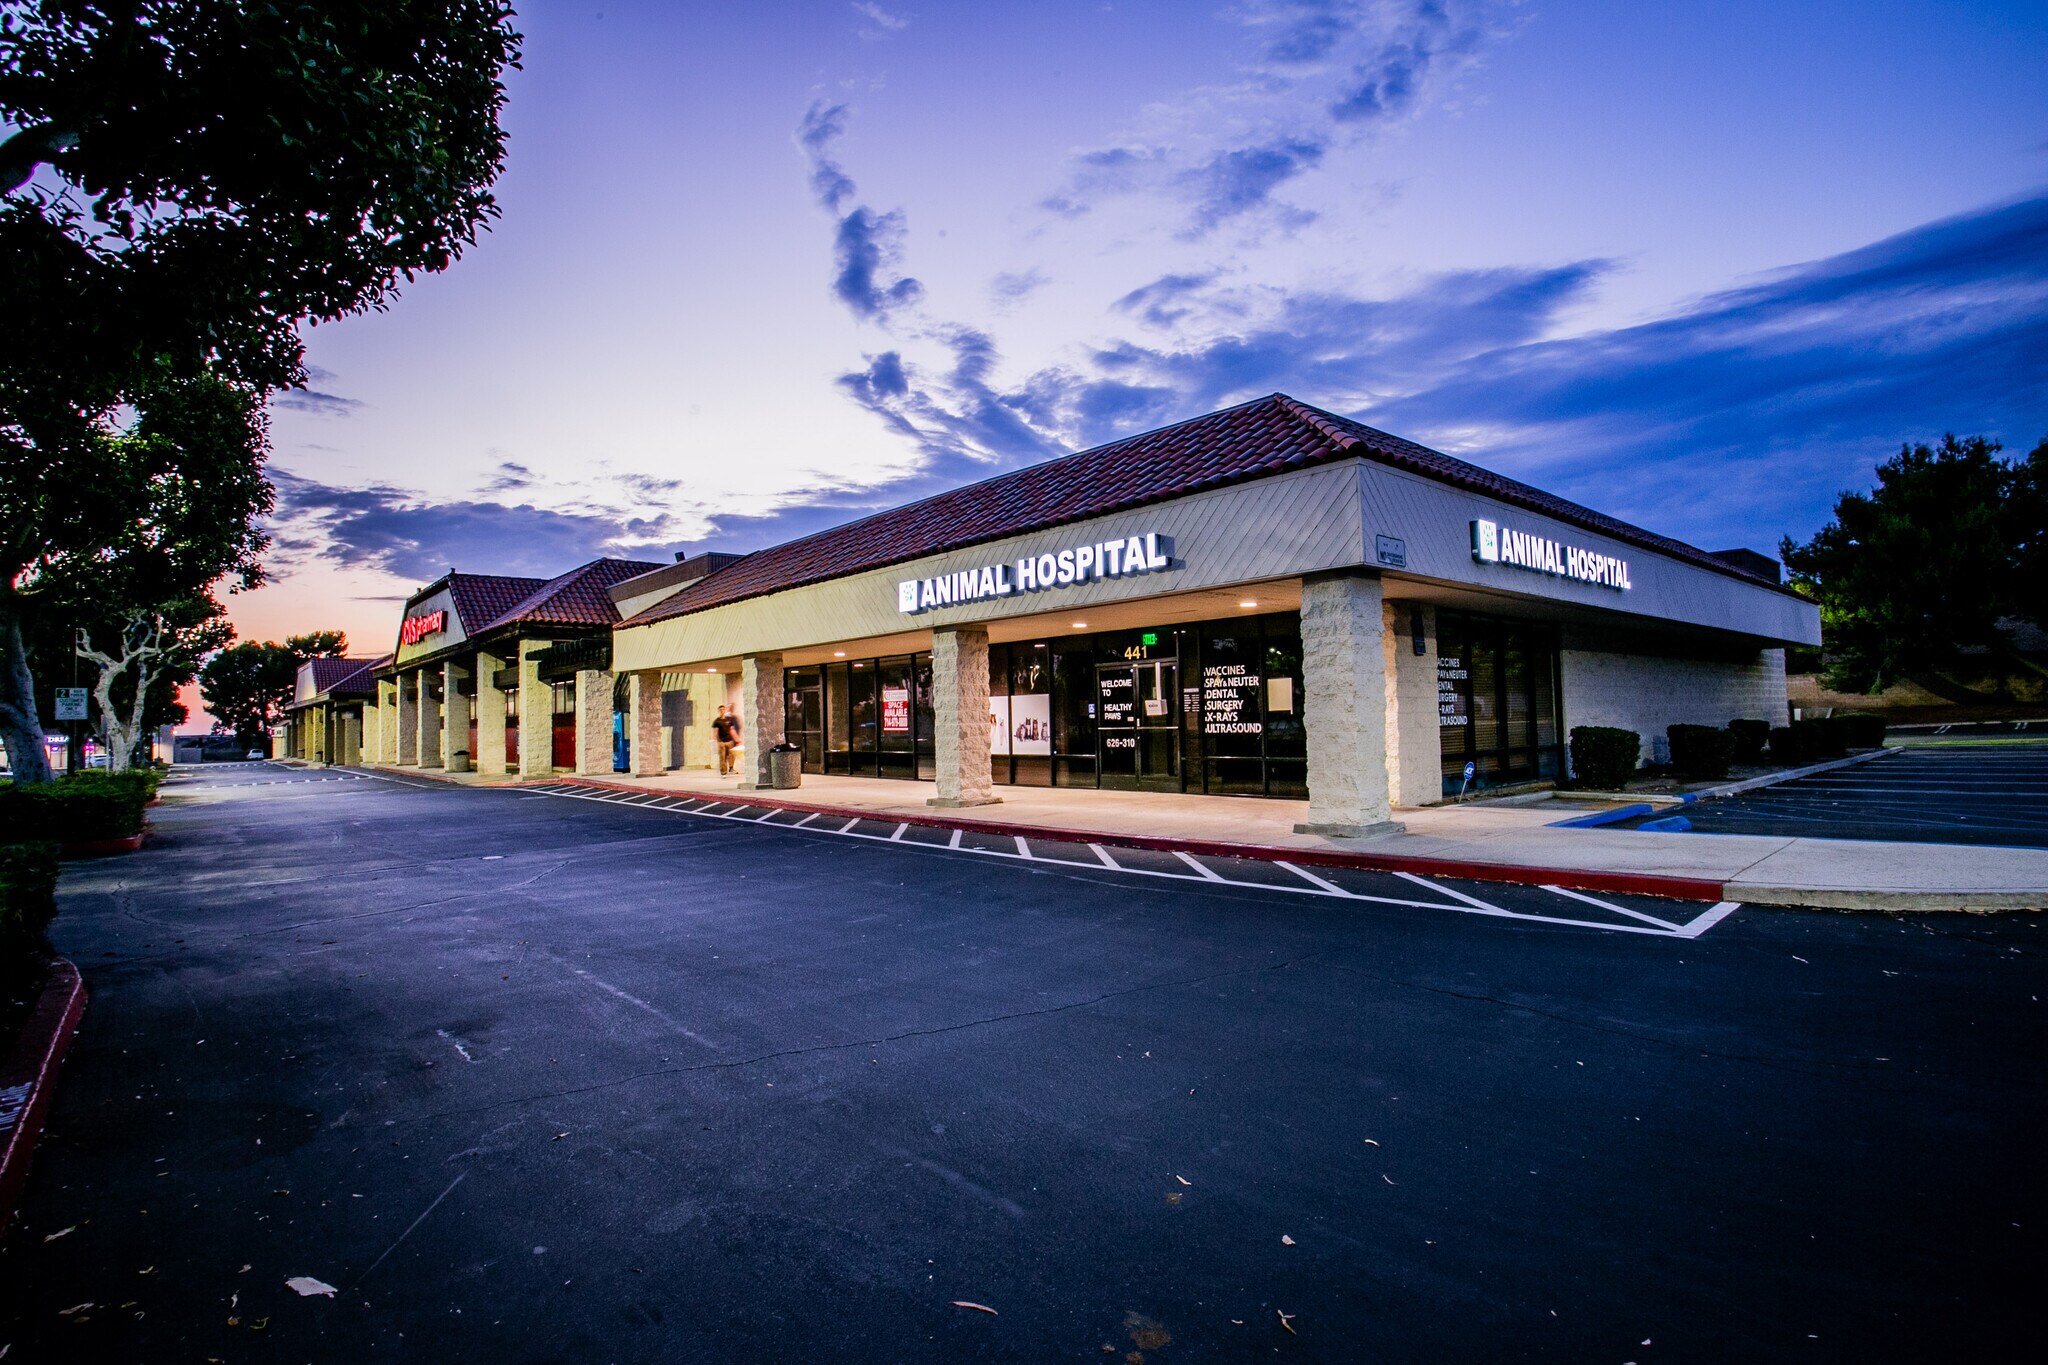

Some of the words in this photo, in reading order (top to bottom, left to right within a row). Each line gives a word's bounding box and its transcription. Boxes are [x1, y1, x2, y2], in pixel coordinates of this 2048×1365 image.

[1501, 528, 1565, 575] ANIMAL
[1568, 546, 1632, 590] HOSPITAL
[920, 563, 1010, 607] ANIMAL
[1018, 533, 1167, 590] HOSPITAL
[402, 617, 416, 646] CVS
[1124, 645, 1148, 660] 441
[1205, 665, 1246, 677] VACCINES
[1100, 678, 1132, 688] WELCOME
[60, 689, 66, 698] 2
[1102, 689, 1112, 697] TO
[1206, 688, 1239, 699] DENTAL
[887, 701, 904, 709] SPACE
[1104, 703, 1133, 711] HEALTHY
[1206, 699, 1244, 711] SURGERY
[884, 708, 908, 717] AVAILABLE
[1104, 712, 1122, 720] PAWS
[1206, 711, 1239, 722] X-RAYS
[1206, 723, 1262, 734] ULTRASOUND
[1106, 738, 1136, 748] 626-310
